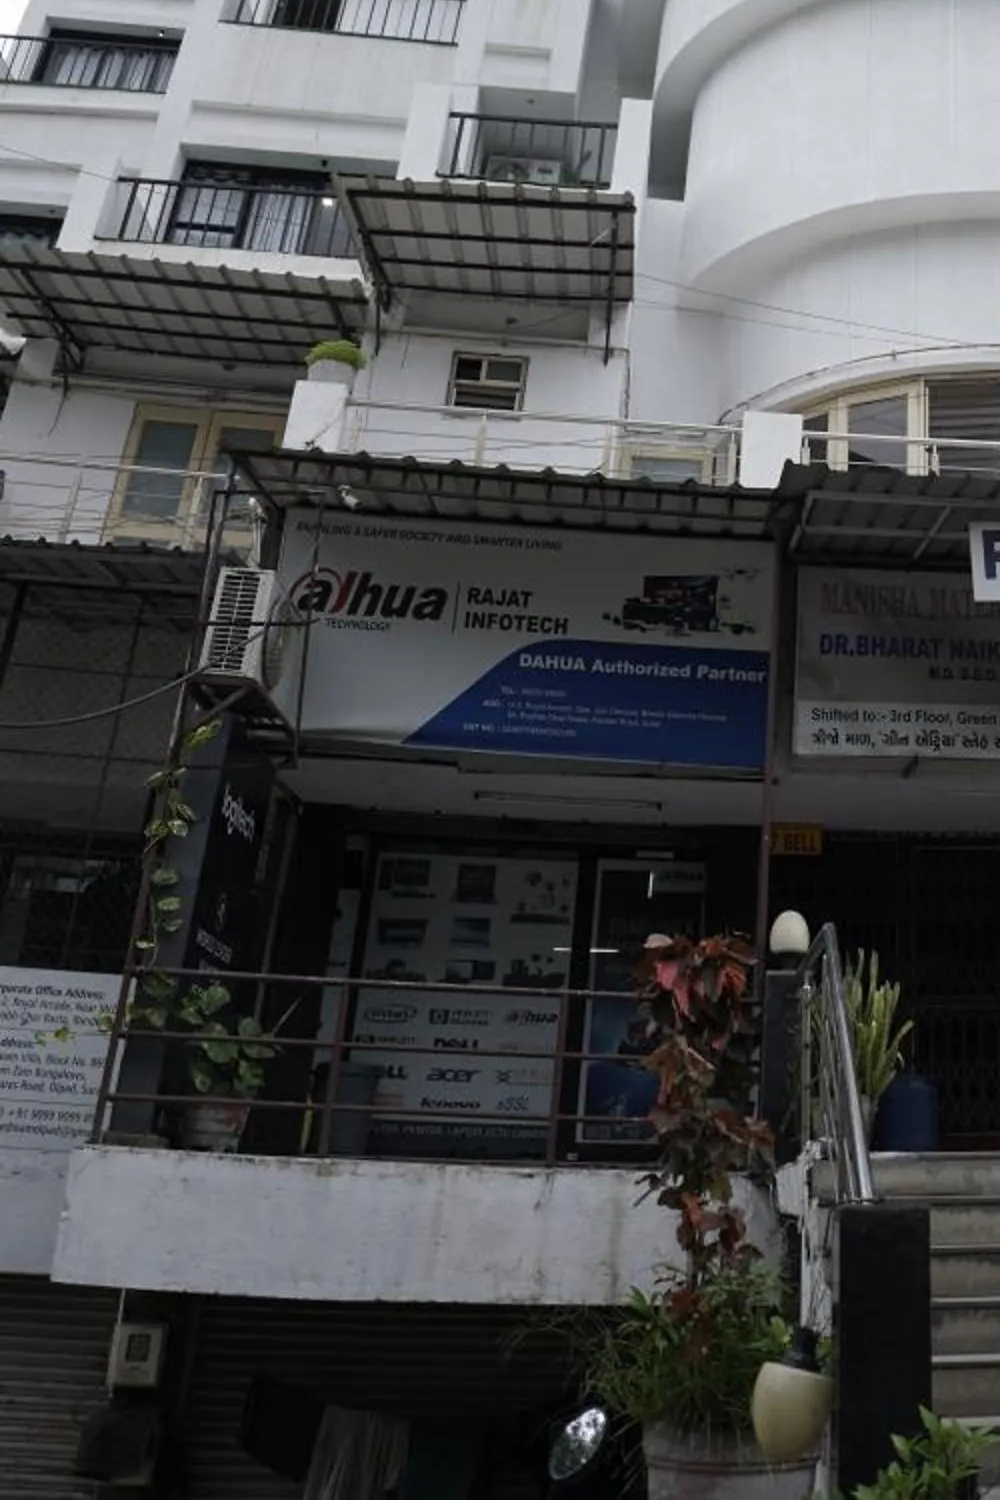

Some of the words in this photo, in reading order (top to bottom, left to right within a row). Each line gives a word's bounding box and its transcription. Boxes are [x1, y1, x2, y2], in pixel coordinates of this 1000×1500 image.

[467, 586, 533, 608] RAJAT
[464, 611, 569, 635] INFOTECH
[819, 633, 942, 660] DR.BHARAT
[519, 652, 586, 672] DAHUA
[591, 658, 691, 679] Authorized
[696, 664, 767, 684] Partner
[811, 707, 859, 724] Shifted
[890, 710, 912, 724] 3rd
[914, 711, 953, 727] Floor,
[957, 713, 997, 726] Green
[35, 986, 63, 997] Office
[425, 1066, 482, 1084] acer
[420, 1096, 481, 1111] lenovo
